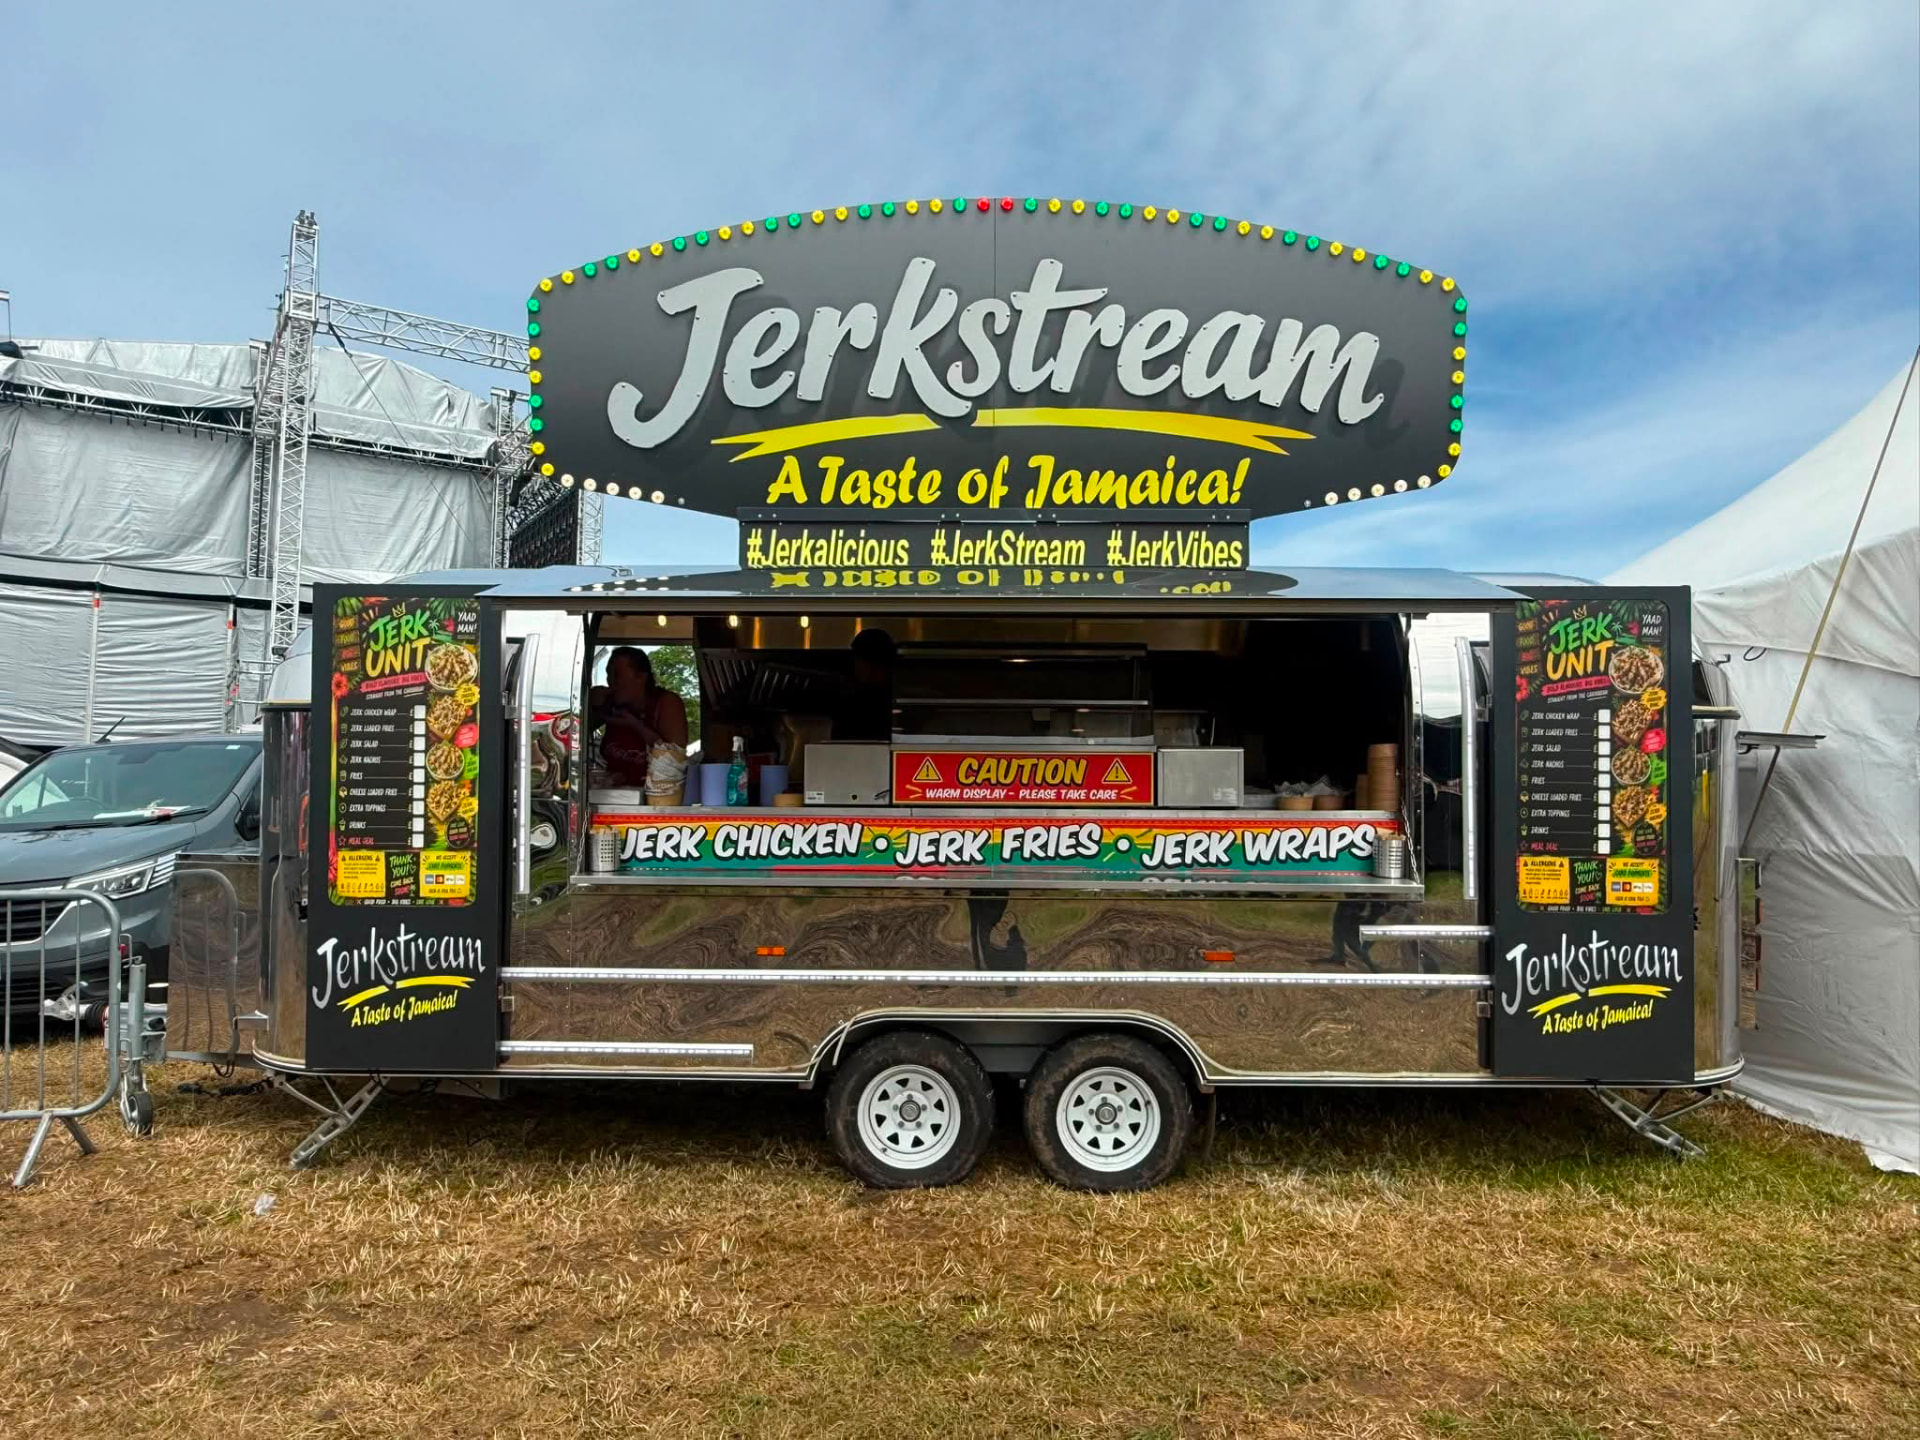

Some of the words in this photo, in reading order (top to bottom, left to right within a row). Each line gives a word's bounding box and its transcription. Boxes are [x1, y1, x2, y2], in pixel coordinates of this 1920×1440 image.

[607, 256, 1385, 449] Jerkstream
[766, 455, 808, 504] A
[818, 455, 942, 509] Taste
[957, 455, 1009, 509] of
[1025, 455, 1251, 509] Jamaica!
[747, 529, 909, 567] #Jerkalicious
[931, 529, 1086, 566] #JerkStream
[1107, 530, 1242, 568] #JerkVibes
[457, 611, 477, 622] YAAD
[1642, 614, 1662, 624] YAAD
[369, 609, 430, 652] JERK
[457, 624, 478, 633] MAN!
[1549, 611, 1614, 655] JERK
[1641, 626, 1662, 635] MAN!
[365, 637, 431, 677] UNIT
[1546, 640, 1615, 681] UNIT
[1532, 712, 1545, 720] JERK
[1546, 712, 1565, 720] CHICKEN
[1567, 712, 1580, 720] WRAP
[1532, 728, 1545, 736] JERK
[1546, 728, 1563, 736] LOADED
[1565, 728, 1578, 736] FRIES
[1532, 744, 1545, 752] JERK
[1546, 744, 1561, 752] SALAD
[958, 757, 1088, 785] CAUTION
[1531, 760, 1545, 769] JERK
[1546, 760, 1564, 768] NACHOS
[1532, 777, 1545, 785] FRIES
[926, 788, 961, 799] WARM
[1019, 789, 1057, 800] PLEASE
[1060, 789, 1087, 800] TAKE
[1089, 789, 1118, 800] CARE
[1531, 793, 1549, 801] CHEESE
[1550, 793, 1568, 801] LOADED
[1569, 793, 1582, 801] FRIES
[349, 804, 364, 812] EXTRA
[1531, 809, 1546, 817] EXTRA
[1548, 809, 1570, 818] TOPPINGS
[1531, 826, 1549, 835] DRINKS
[620, 826, 706, 860] JERK
[713, 822, 863, 858] CHICKEN
[895, 830, 990, 864] JERK
[1002, 823, 1102, 859] FRIES
[1142, 830, 1236, 867] JERK
[1243, 823, 1376, 863] WRAPS
[389, 854, 412, 867] THANK
[1573, 860, 1598, 873] THANK
[392, 865, 409, 878] YOU!
[1576, 871, 1595, 884] YOU!
[312, 922, 486, 1009] Jerkstream
[1501, 930, 1683, 1015] Jerkstream
[351, 1007, 361, 1027] A
[363, 1002, 391, 1025] Taste
[393, 998, 405, 1022] of
[408, 989, 458, 1020] Jamaica!
[1542, 1014, 1553, 1034] A
[1554, 1010, 1583, 1033] Taste
[1586, 1006, 1598, 1031] of
[1601, 998, 1654, 1030] Jamaica!
